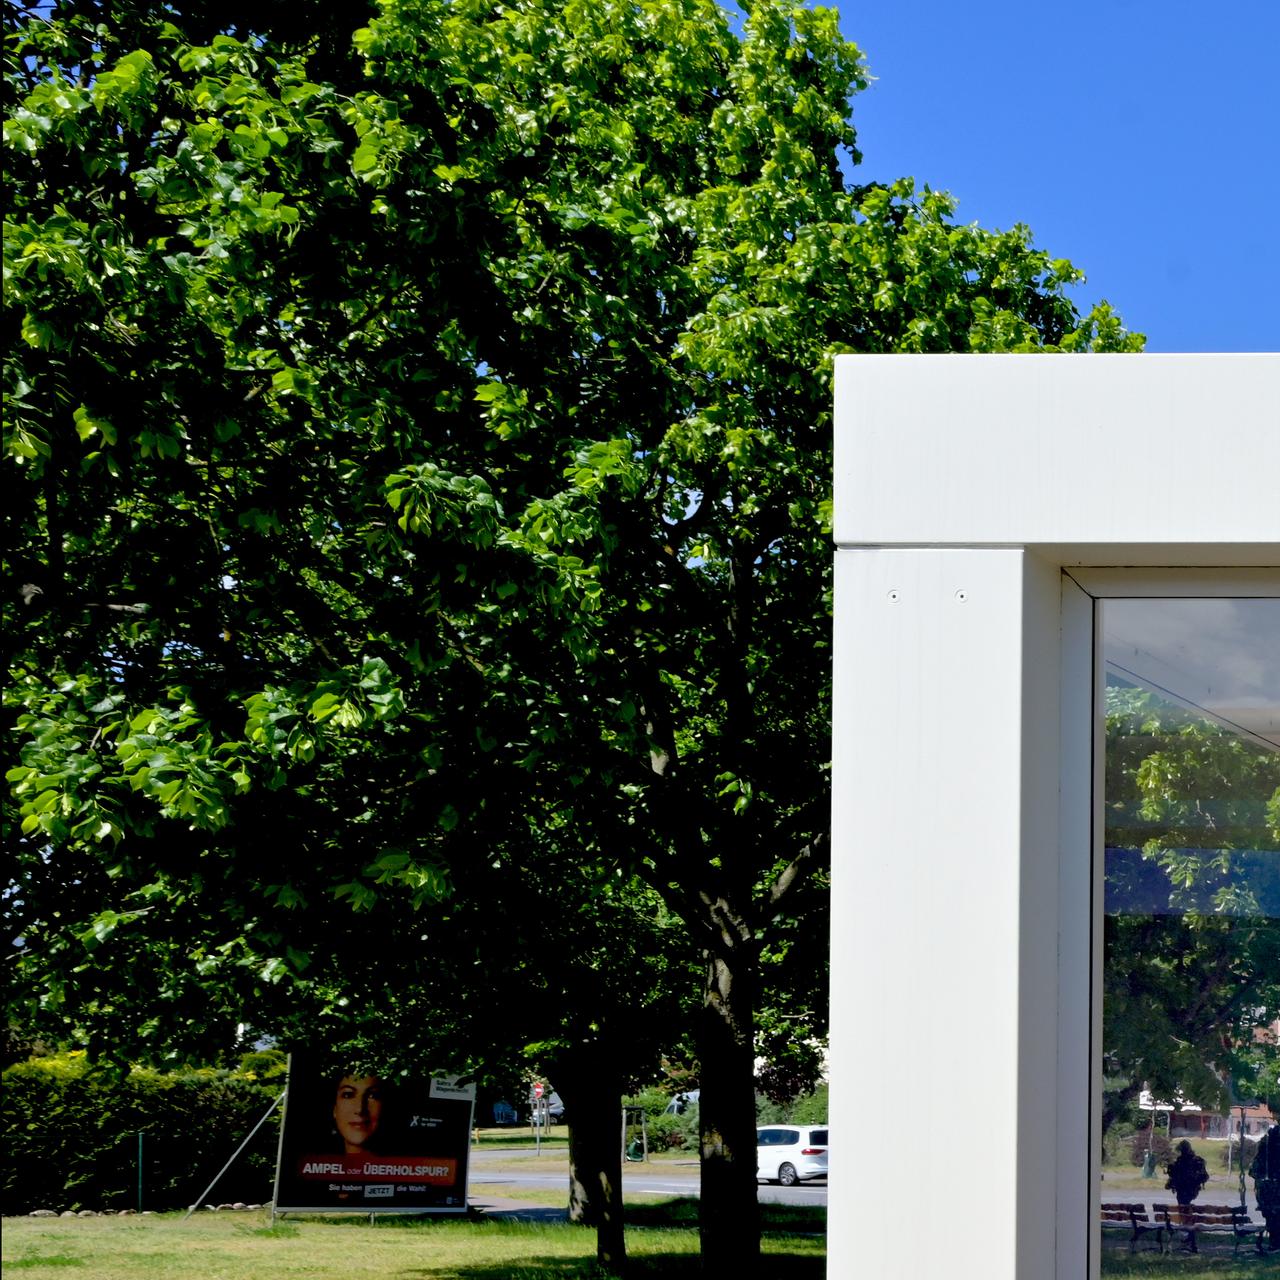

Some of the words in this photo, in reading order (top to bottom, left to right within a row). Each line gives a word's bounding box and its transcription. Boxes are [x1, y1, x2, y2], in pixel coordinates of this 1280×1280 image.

[302, 1163, 345, 1174] AMPEL
[363, 1163, 449, 1177] ÜBERHOLSPUR?
[368, 1187, 390, 1195] JETZT
